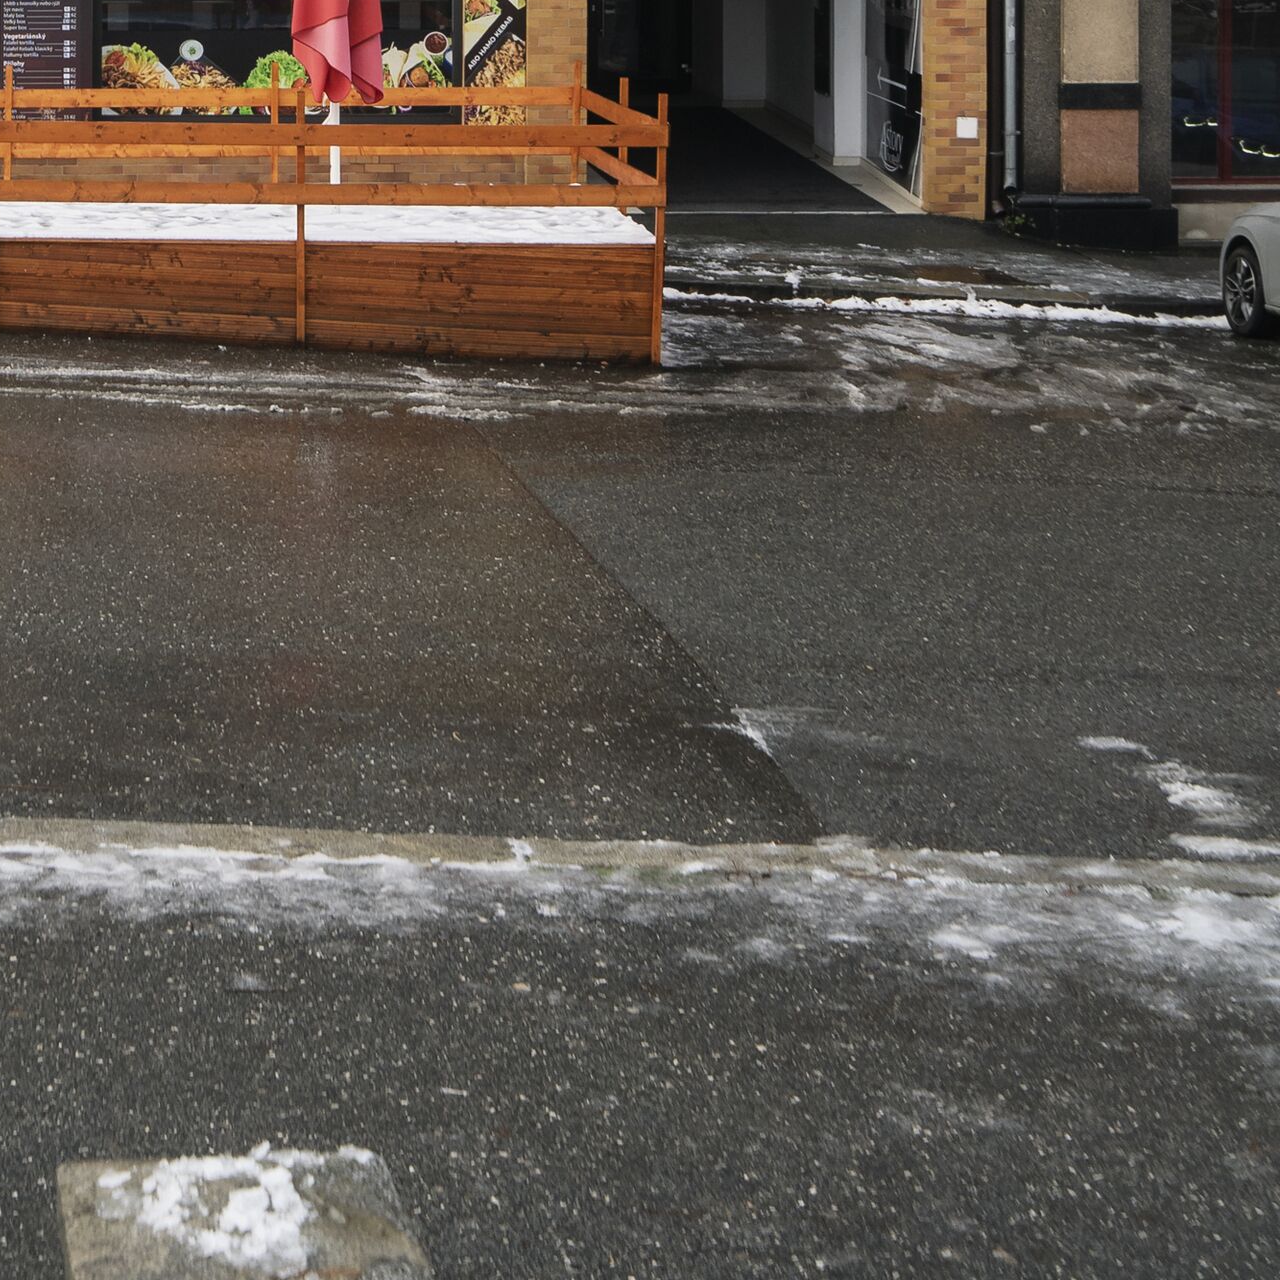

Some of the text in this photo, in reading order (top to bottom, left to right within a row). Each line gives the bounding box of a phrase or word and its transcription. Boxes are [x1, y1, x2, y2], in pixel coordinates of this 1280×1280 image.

[467, 15, 514, 70] ABO HAMO KEBAB
